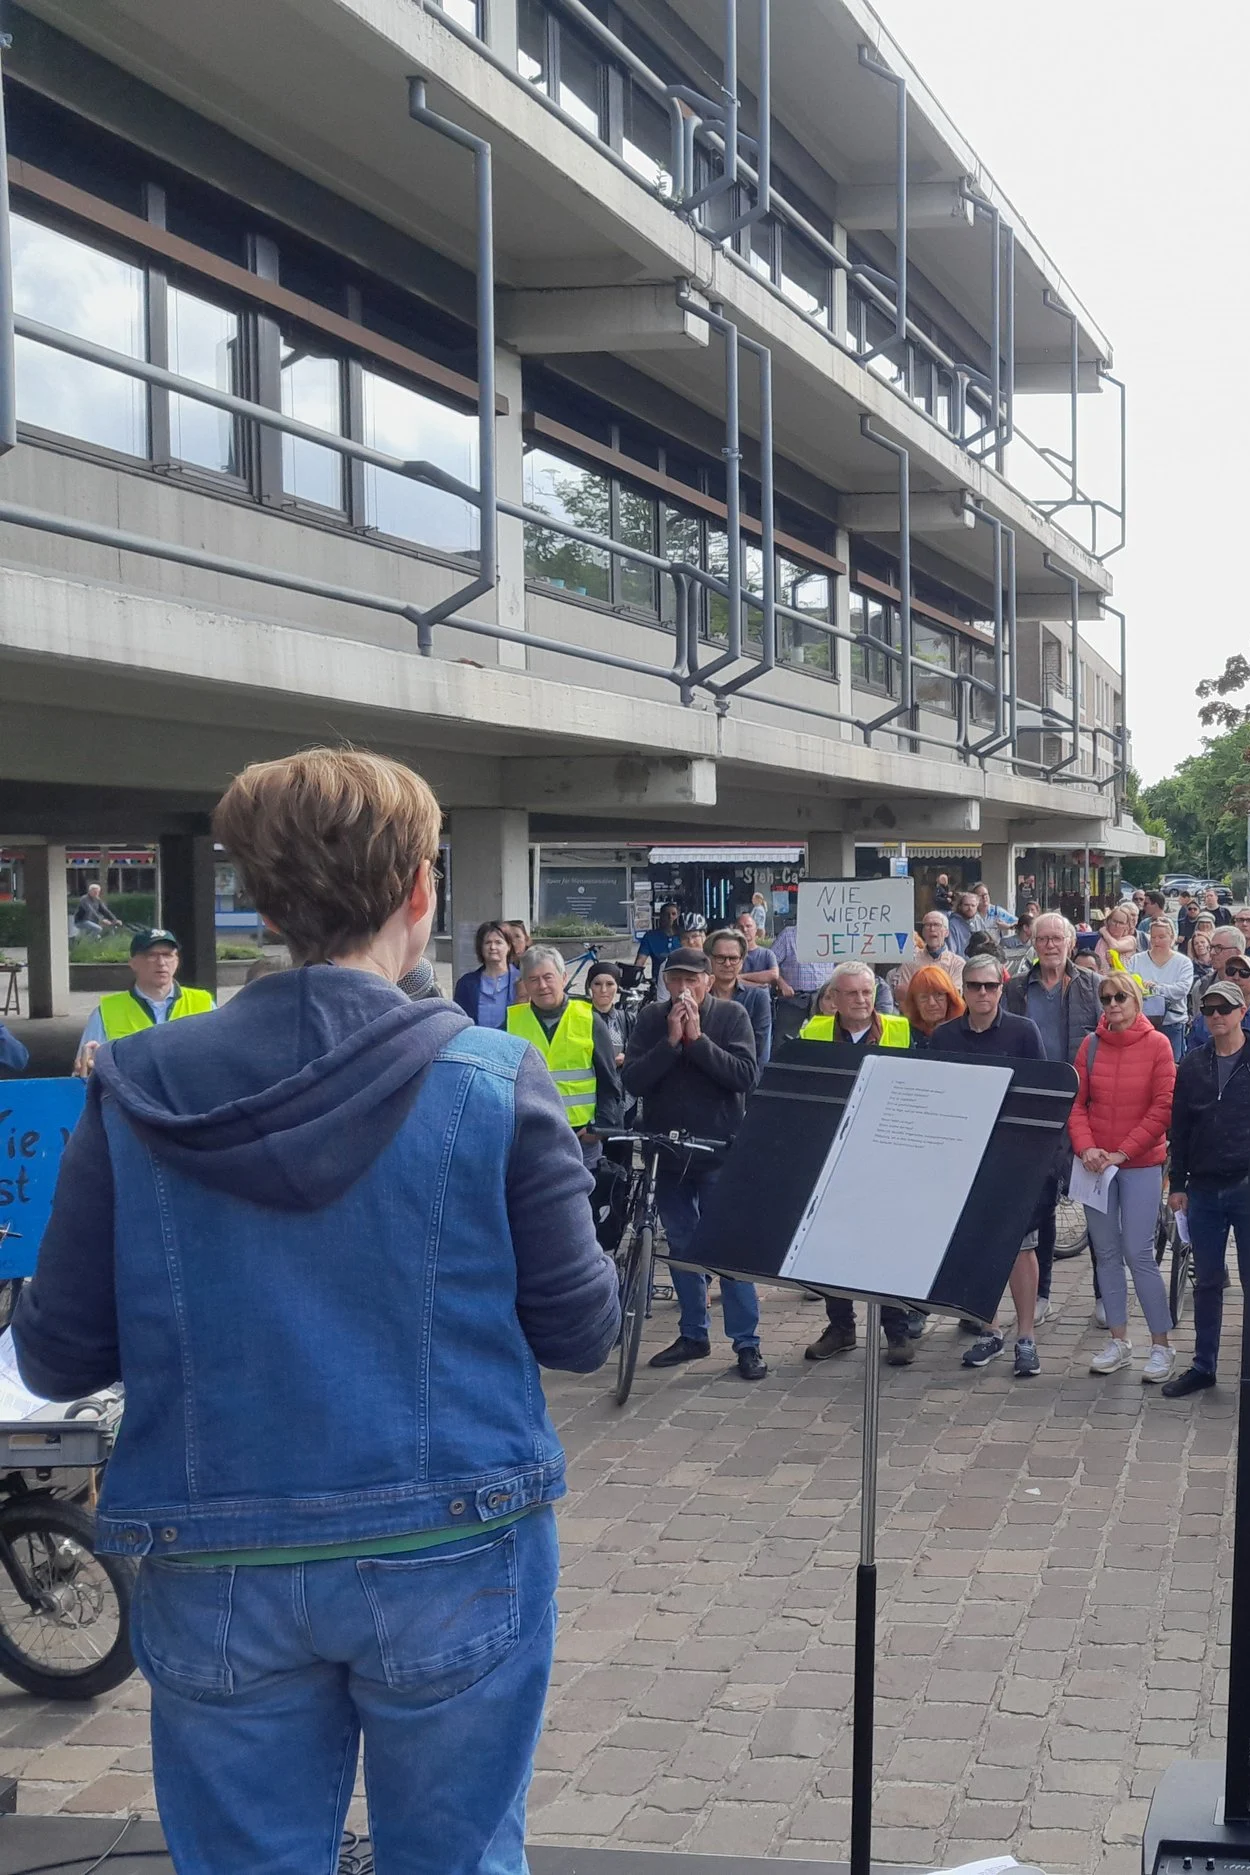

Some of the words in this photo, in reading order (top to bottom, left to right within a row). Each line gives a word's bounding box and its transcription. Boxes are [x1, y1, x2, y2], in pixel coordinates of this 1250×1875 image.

[816, 886, 862, 907] NIE
[823, 904, 891, 922] WIEDER
[846, 922, 871, 935] IST
[0, 1109, 40, 1159] ie
